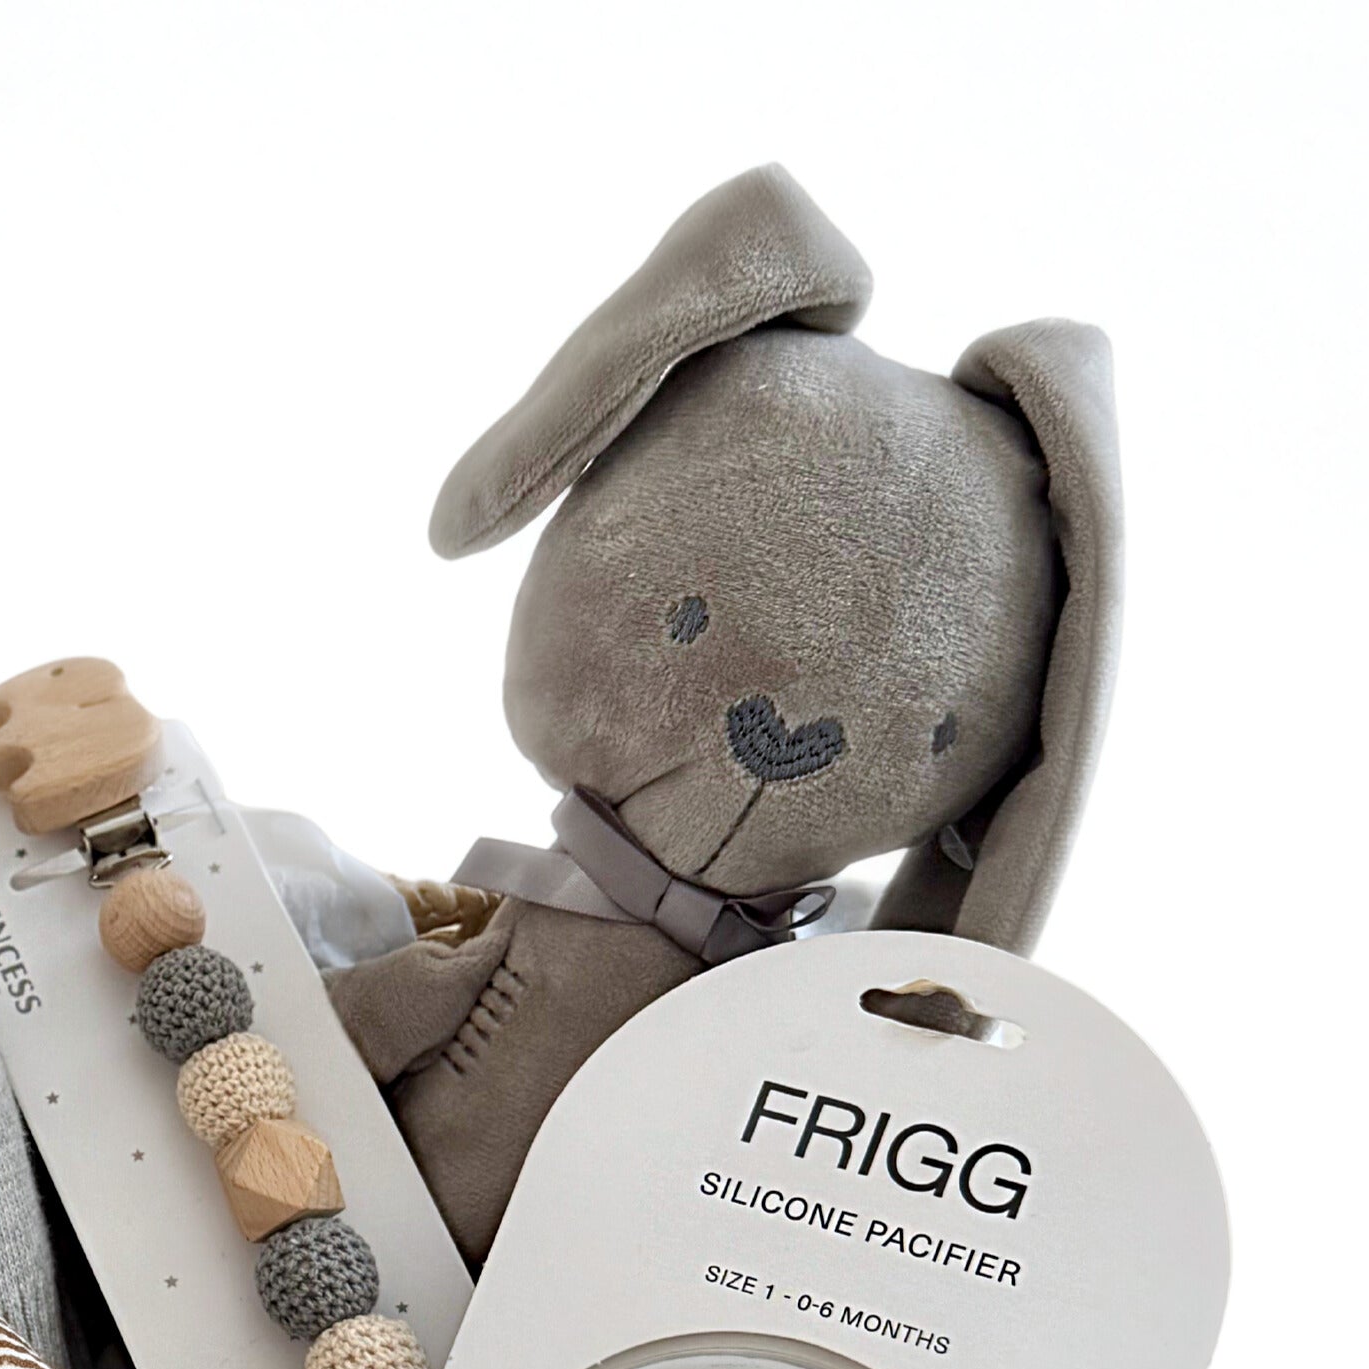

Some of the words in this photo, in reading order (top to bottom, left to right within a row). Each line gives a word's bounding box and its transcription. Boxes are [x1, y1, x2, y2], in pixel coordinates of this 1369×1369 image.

[740, 1080, 1032, 1220] FRIGG
[699, 1172, 858, 1237] SILICONE
[864, 1219, 1022, 1286] PACIFIER
[705, 1265, 758, 1295] SIZE
[764, 1284, 775, 1300] 1
[797, 1294, 834, 1318] 0-6
[840, 1306, 951, 1355] MONTHS
